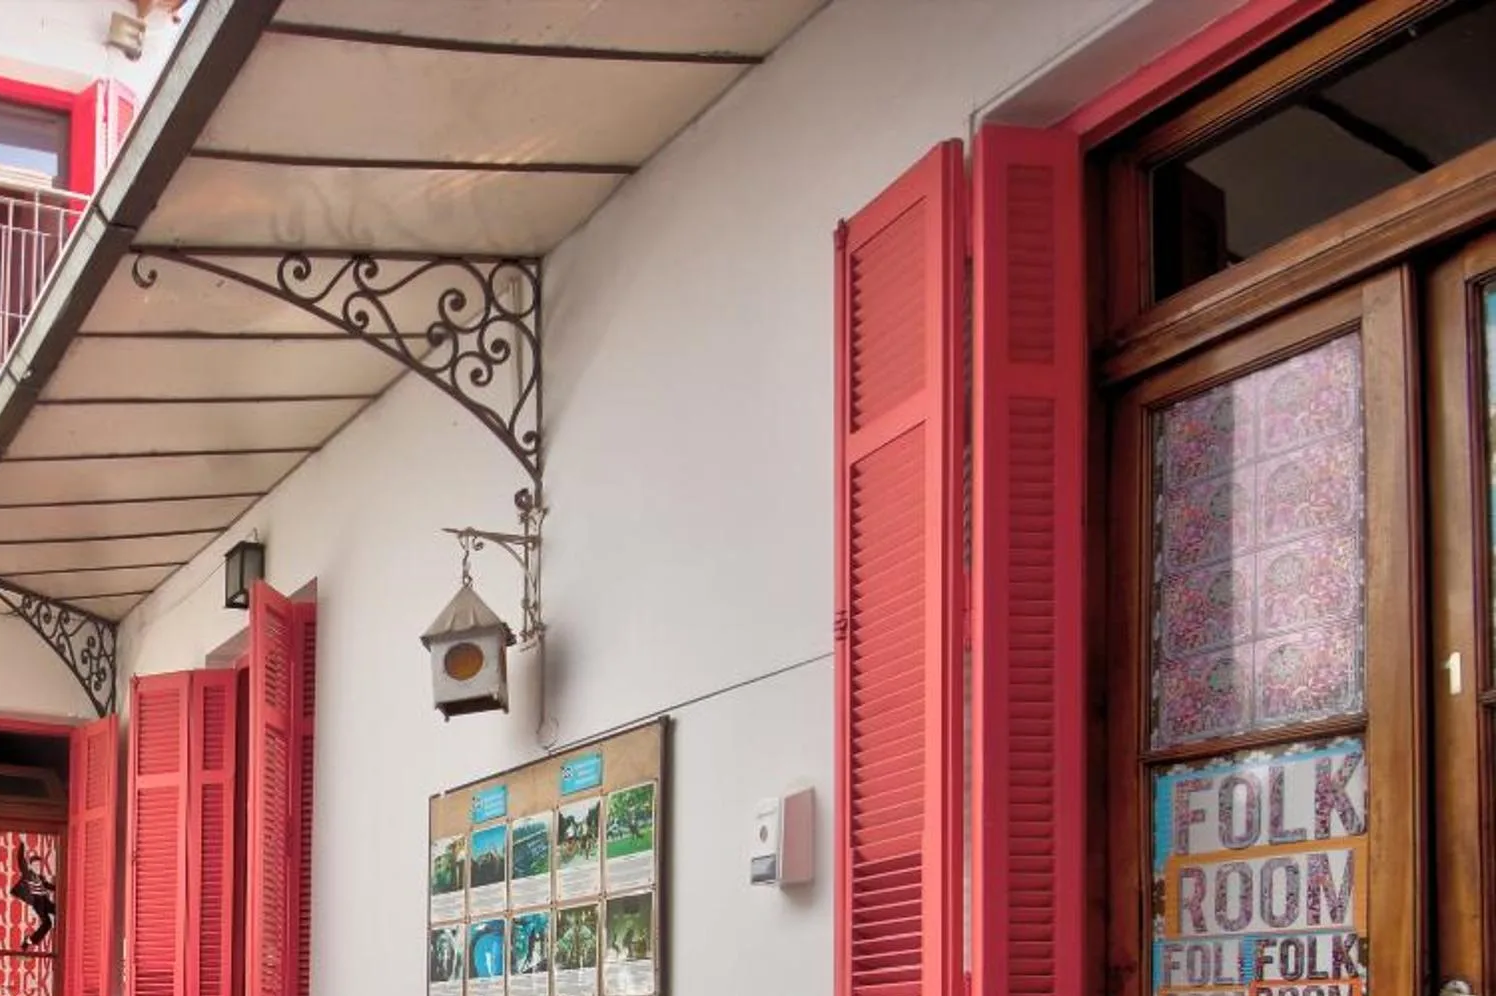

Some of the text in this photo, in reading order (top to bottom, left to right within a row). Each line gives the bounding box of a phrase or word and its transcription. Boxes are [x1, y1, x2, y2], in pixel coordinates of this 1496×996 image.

[1445, 650, 1462, 695] 1
[1171, 751, 1366, 857] FOLK
[1178, 848, 1355, 935] ROOM
[1256, 933, 1359, 982] FOLK
